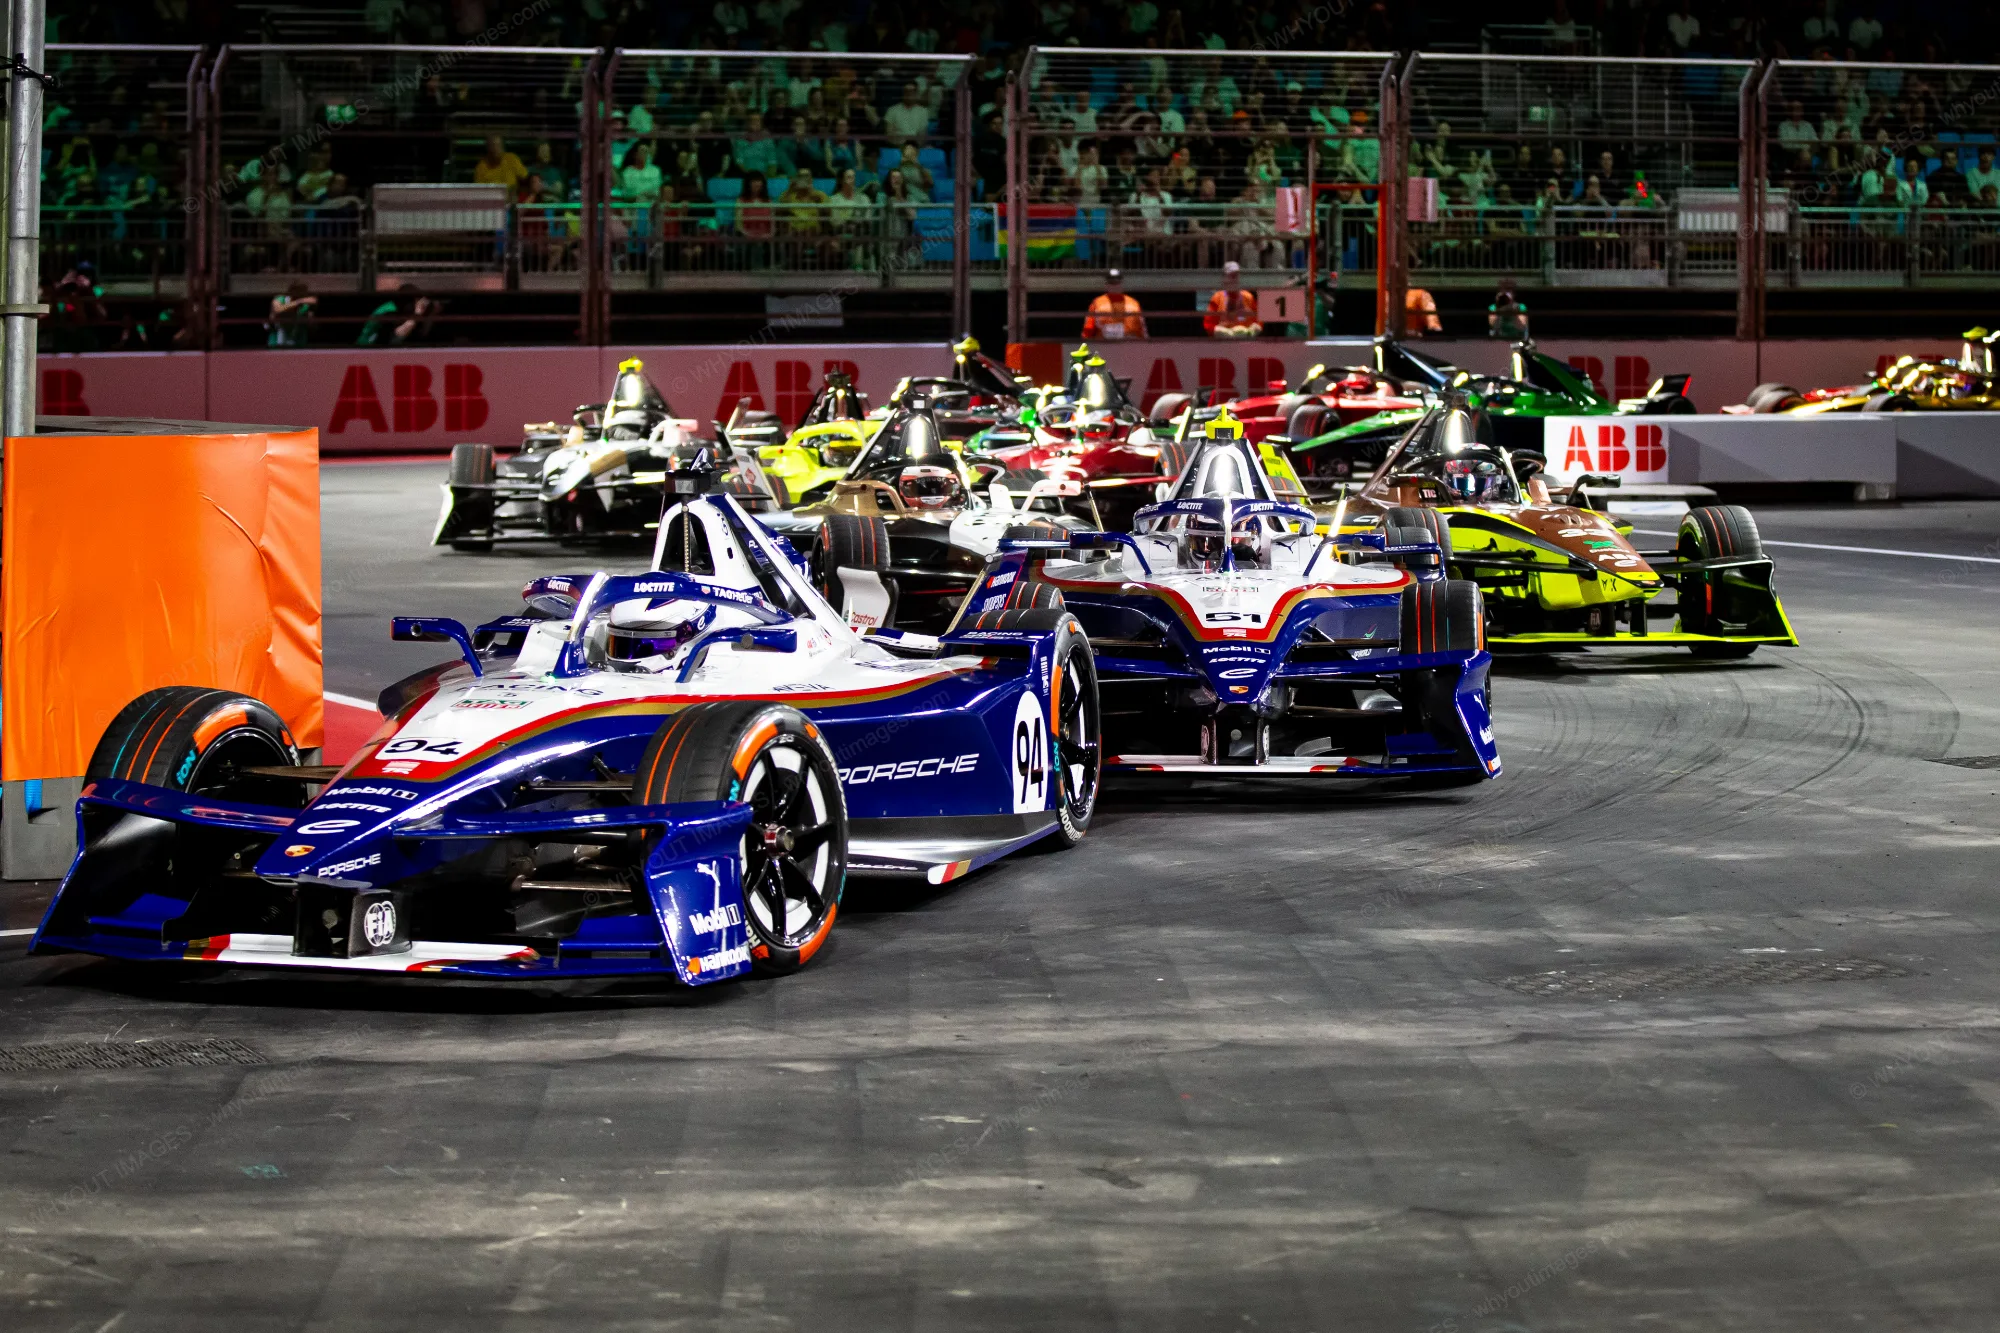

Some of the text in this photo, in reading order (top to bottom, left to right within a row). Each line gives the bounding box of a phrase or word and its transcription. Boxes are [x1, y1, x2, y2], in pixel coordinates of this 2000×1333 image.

[1275, 297, 1286, 317] 1
[328, 364, 489, 433] ABB
[1563, 425, 1667, 472] ABB
[1177, 502, 1203, 511] LOCTITE
[1250, 502, 1274, 511] LOCTITE
[547, 580, 570, 592] LOCTITE
[634, 582, 675, 593] LOCTITE
[1206, 611, 1261, 623] 51
[1203, 645, 1252, 654] Mobil
[1208, 656, 1266, 664] LOCTITE
[384, 739, 463, 756] 94
[1016, 709, 1045, 805] 94
[838, 753, 980, 785] PORSCHE
[325, 786, 392, 798] Mobil
[312, 801, 392, 814] LOCTITE
[317, 852, 381, 879] PORSCHE
[367, 908, 393, 936] FIA
[688, 906, 731, 936] Mobil
